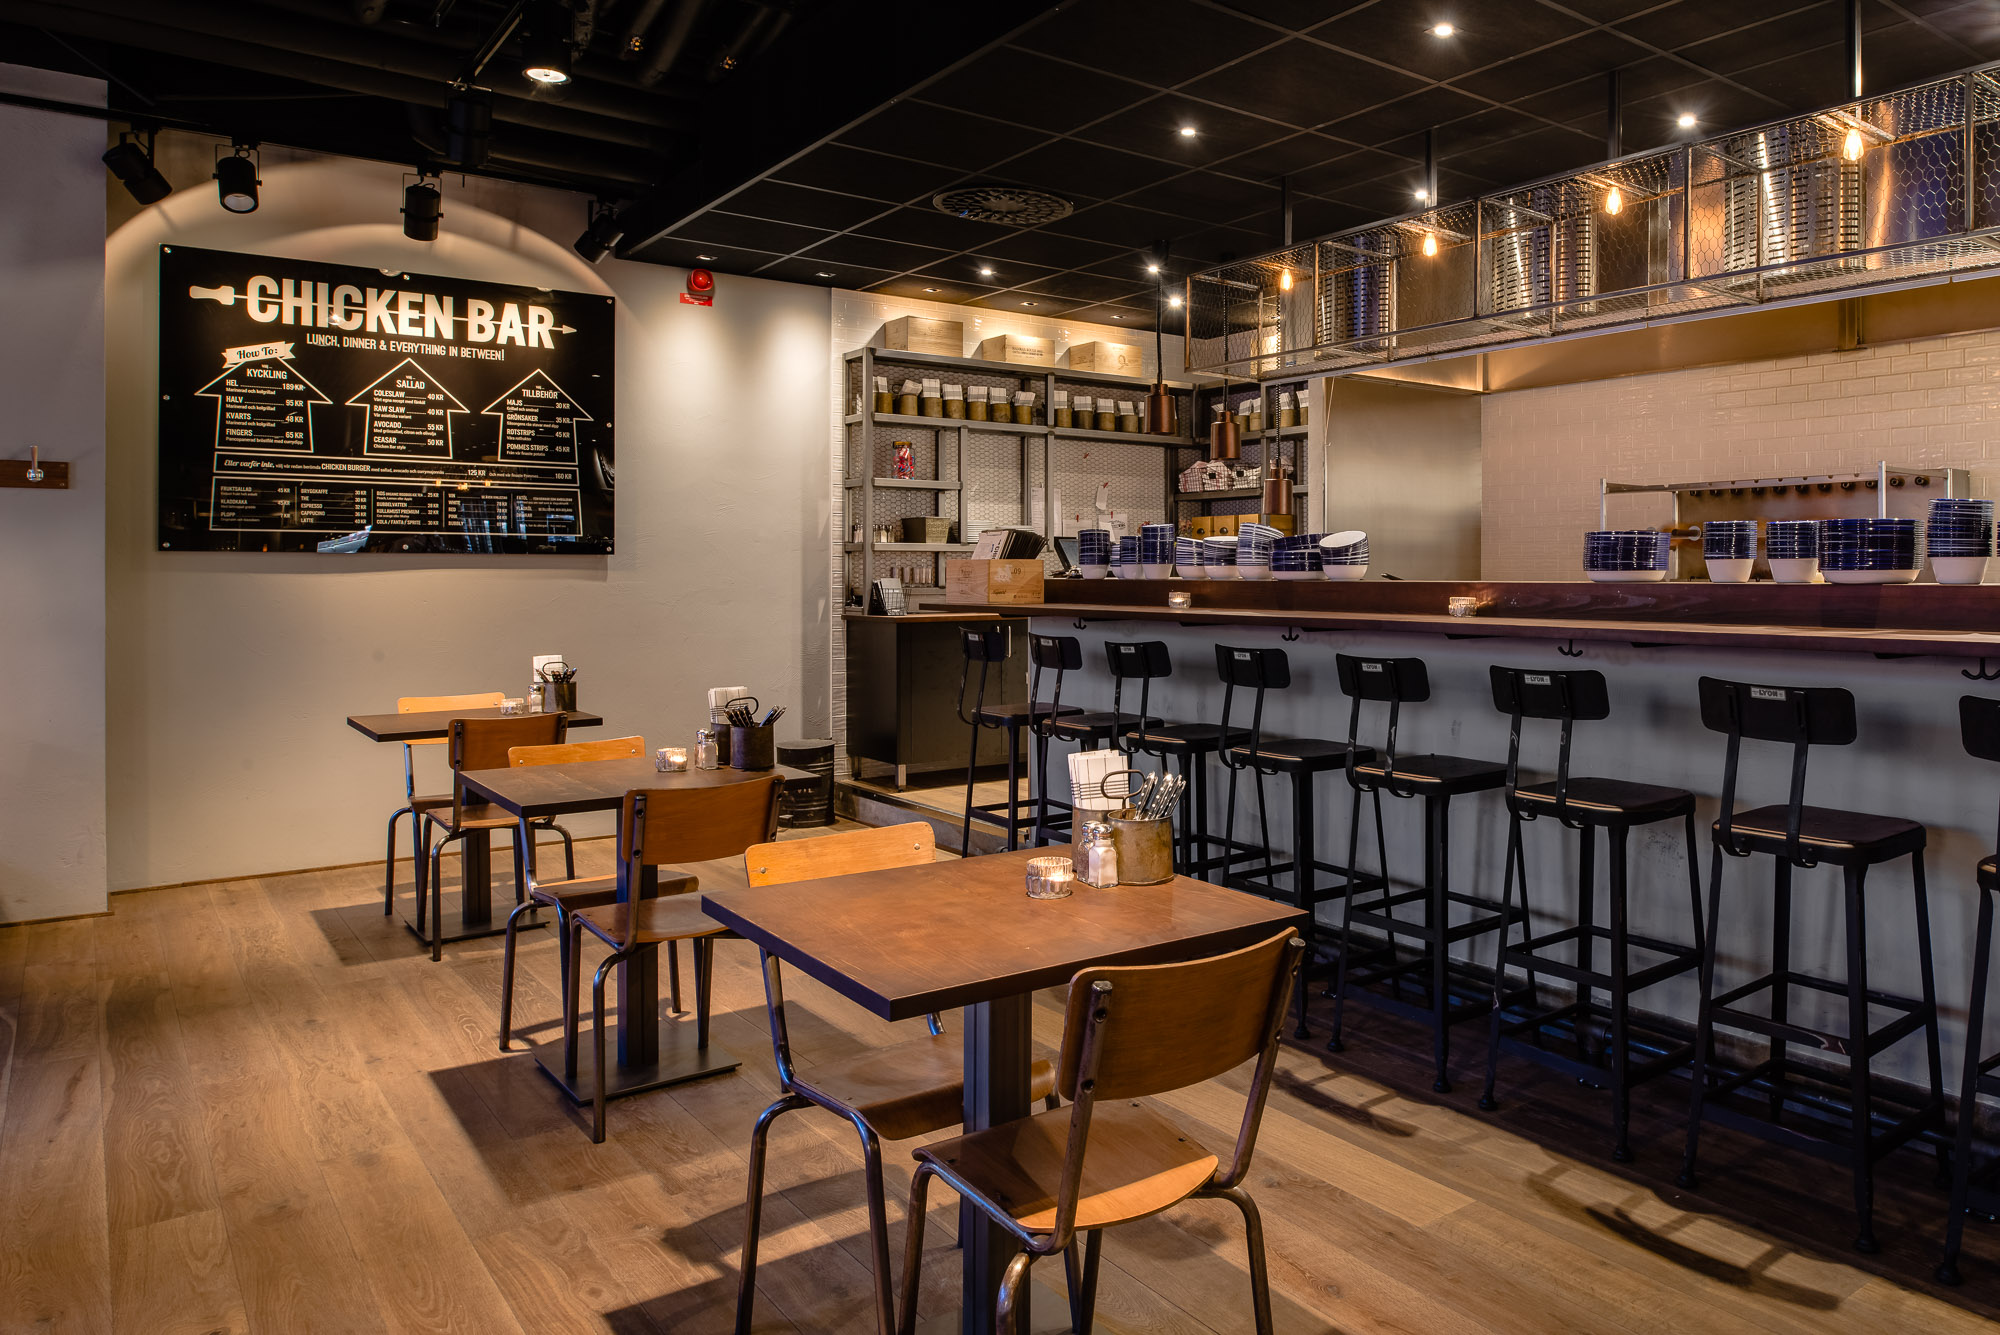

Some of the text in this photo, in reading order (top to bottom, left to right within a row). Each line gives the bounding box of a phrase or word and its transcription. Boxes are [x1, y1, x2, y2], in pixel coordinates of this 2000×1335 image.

[247, 275, 555, 349] CHICKEN BAR
[306, 333, 505, 361] LUNCH, DINNER & EVERYTHING IN BETWEEN!
[236, 346, 278, 359] How To:
[246, 368, 288, 380] KYCKLING
[226, 379, 239, 387] HEL
[396, 380, 425, 390] SALLAD
[374, 390, 405, 398] COLESLAW
[522, 389, 558, 399] TILLBEHÖR
[388, 406, 405, 414] SLAW
[226, 412, 252, 420] KVARTS
[507, 413, 538, 422] GRÖNSAKER
[374, 421, 402, 429] AVOCADO
[507, 428, 535, 437] ROTSTRIPS
[374, 436, 397, 444] CEASAR
[507, 443, 530, 451] POMMES
[531, 444, 549, 452] STRIPS
[240, 460, 260, 469] varför
[321, 463, 347, 471] CHICKEN
[347, 464, 371, 472] BURGER
